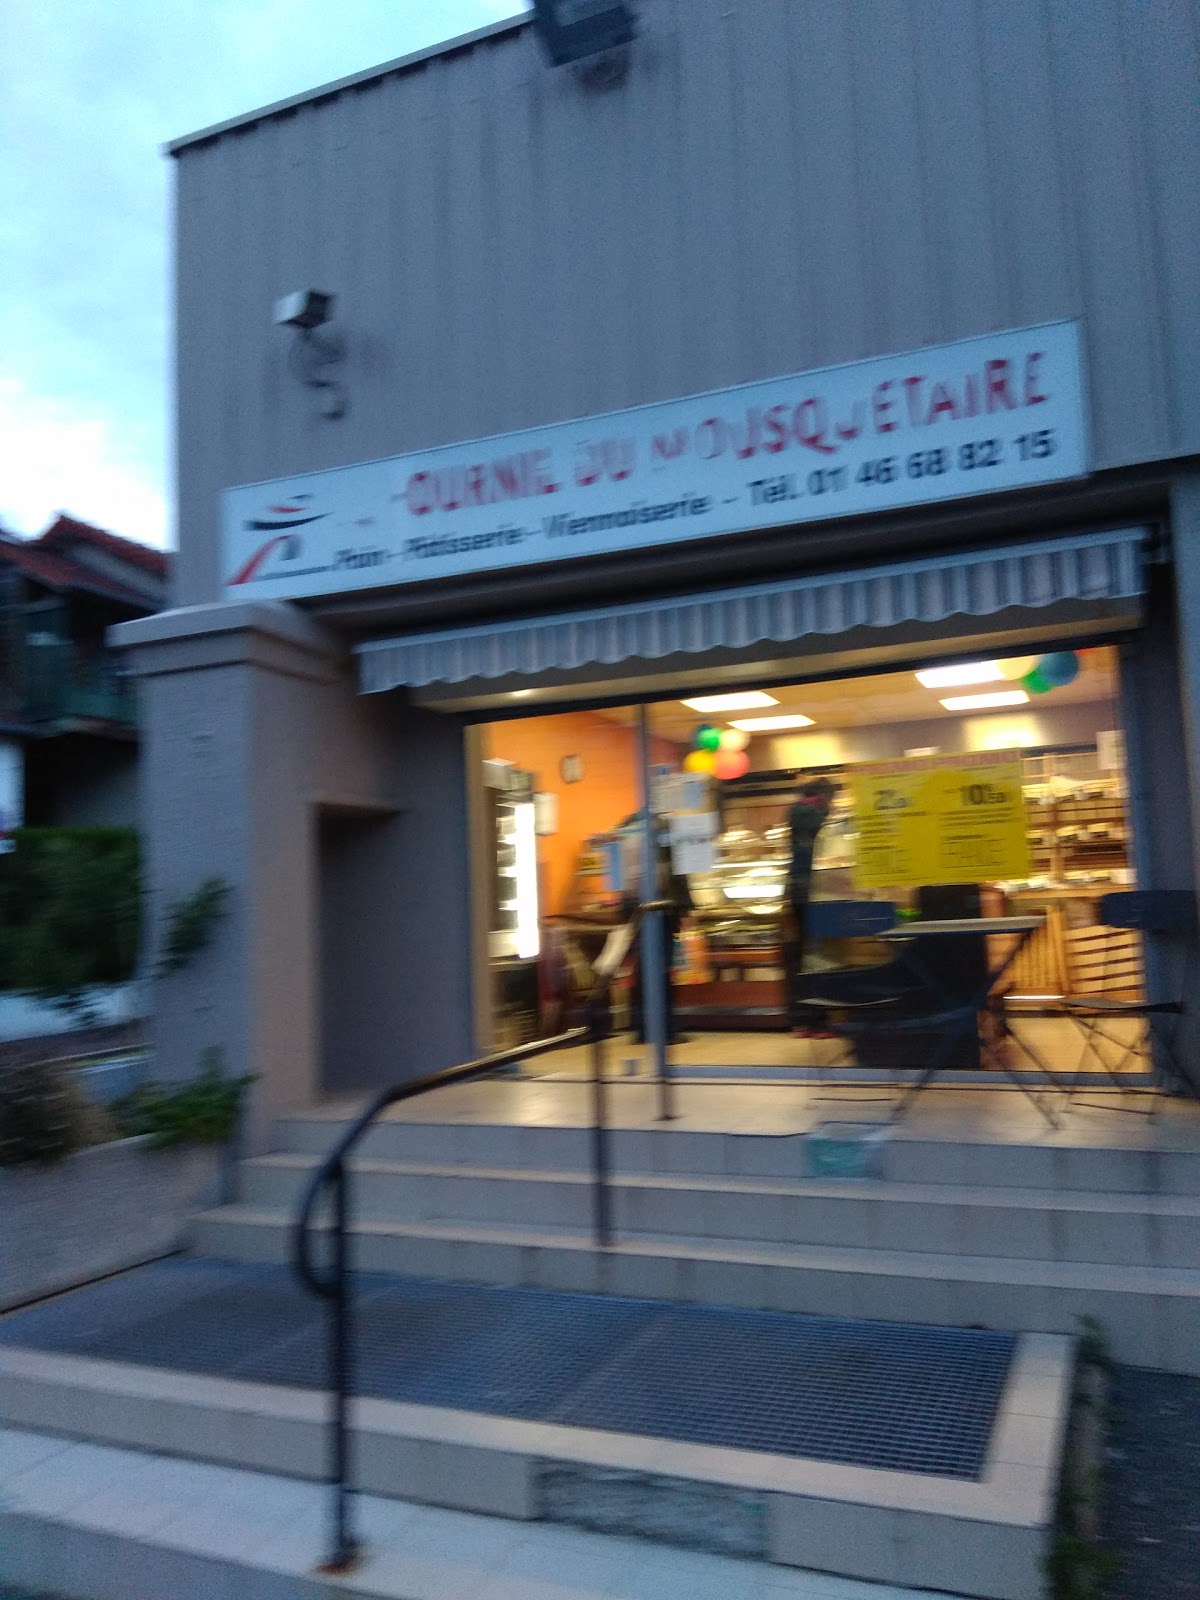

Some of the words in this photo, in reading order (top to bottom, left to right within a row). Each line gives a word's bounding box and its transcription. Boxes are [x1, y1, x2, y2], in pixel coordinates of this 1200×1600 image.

[855, 456, 898, 487] 46
[905, 447, 948, 480] 68
[956, 438, 1003, 471] 82
[1013, 429, 1058, 462] 15
